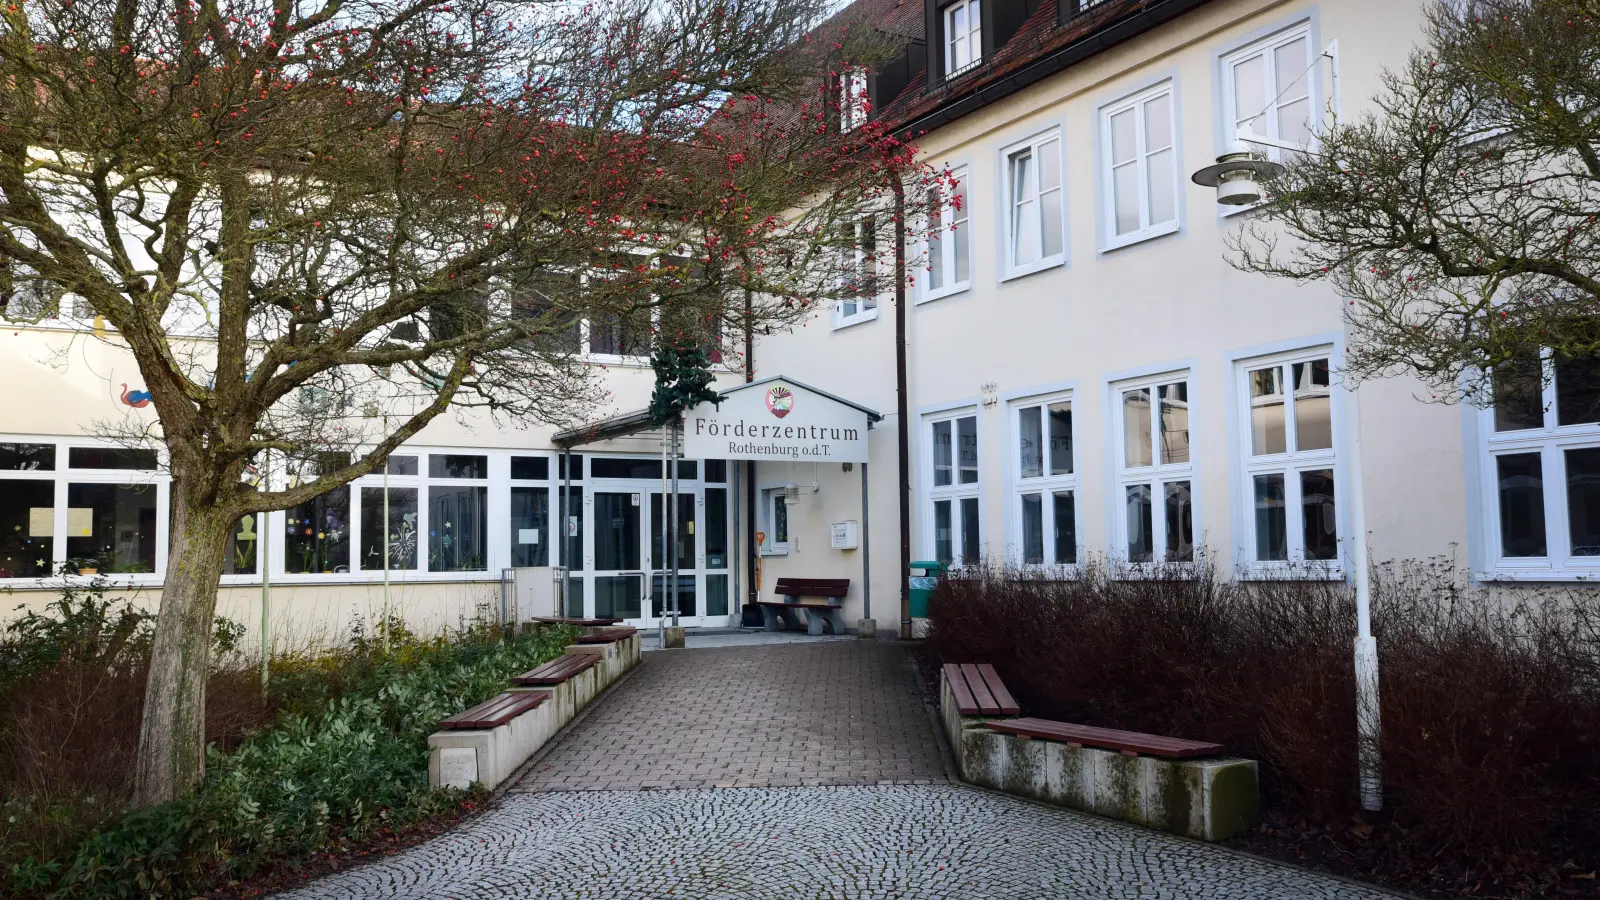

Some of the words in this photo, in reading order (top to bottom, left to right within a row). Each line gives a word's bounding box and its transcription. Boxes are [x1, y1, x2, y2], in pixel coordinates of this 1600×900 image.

[695, 418, 859, 441] Förderzentrum
[728, 442, 799, 458] Rothenburg
[802, 444, 831, 456] o.d.T.
